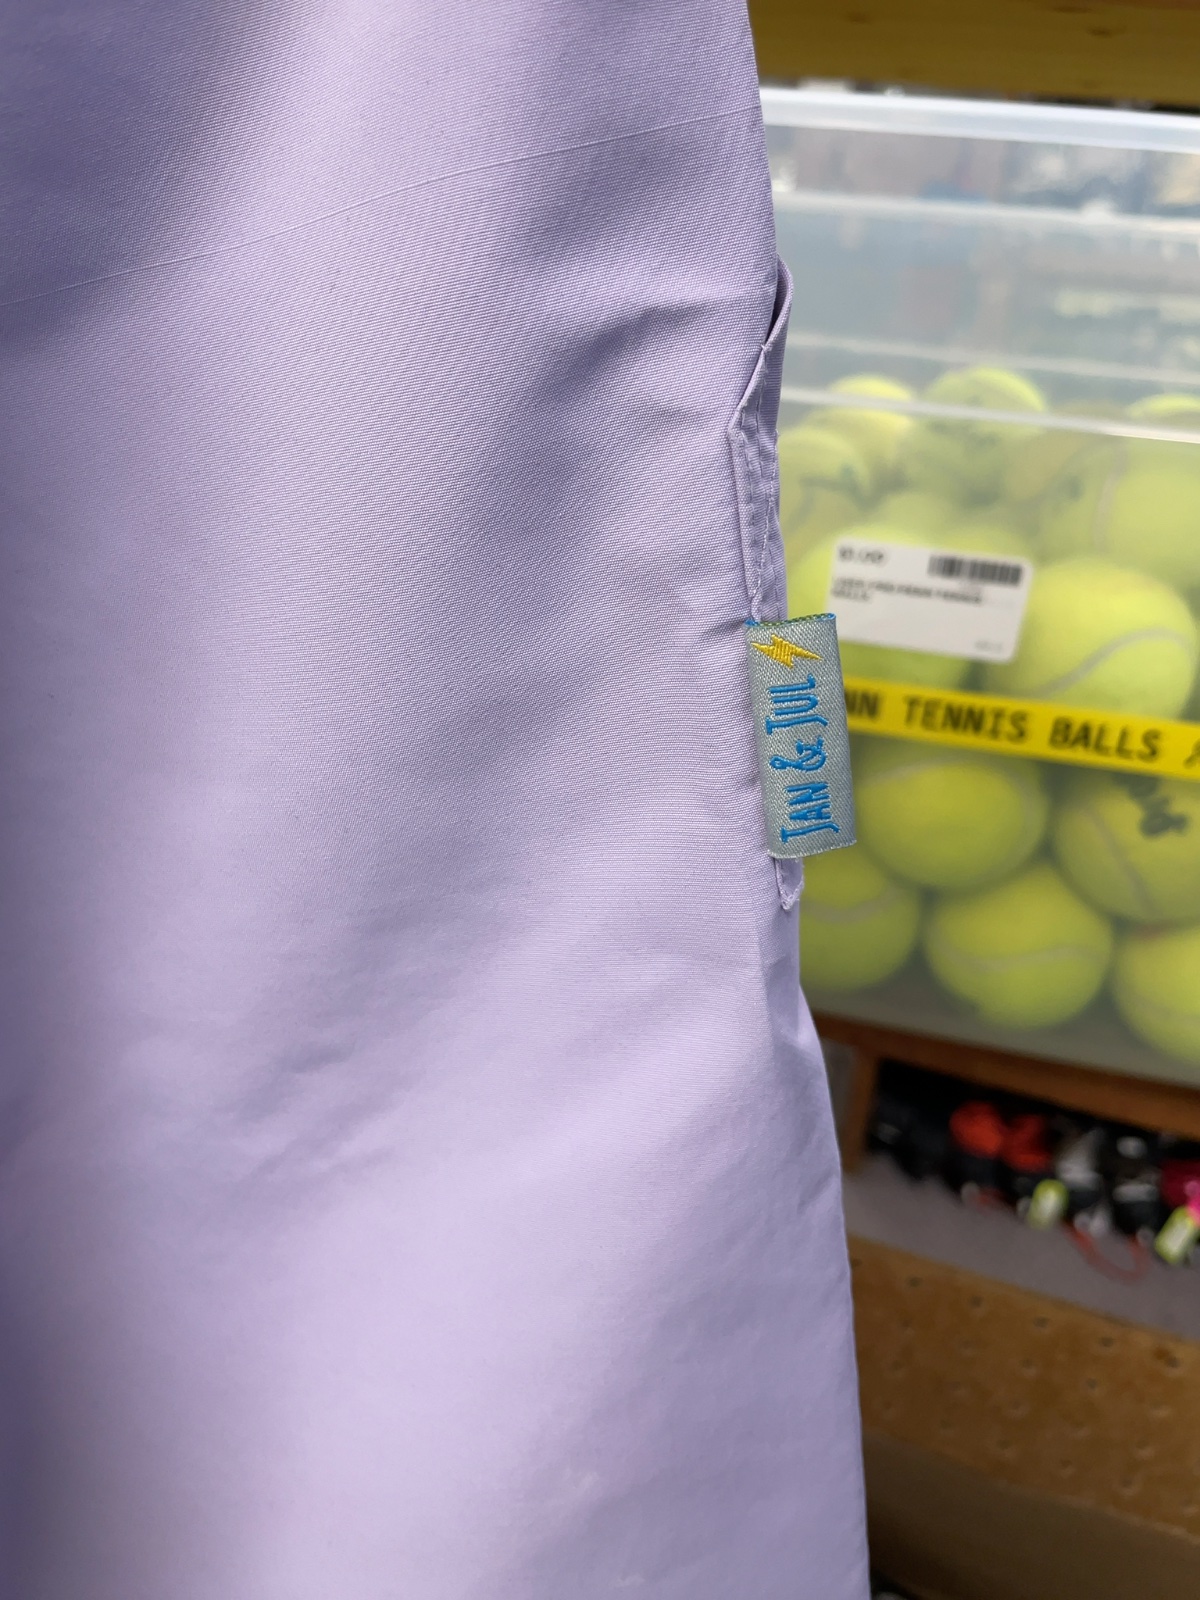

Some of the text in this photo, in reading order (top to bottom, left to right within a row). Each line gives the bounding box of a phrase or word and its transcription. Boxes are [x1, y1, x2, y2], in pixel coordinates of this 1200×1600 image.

[766, 673, 840, 843] JAN & JUL
[844, 689, 879, 719] NN
[904, 695, 1028, 743] TENNIS
[1049, 716, 1161, 763] BALLS
